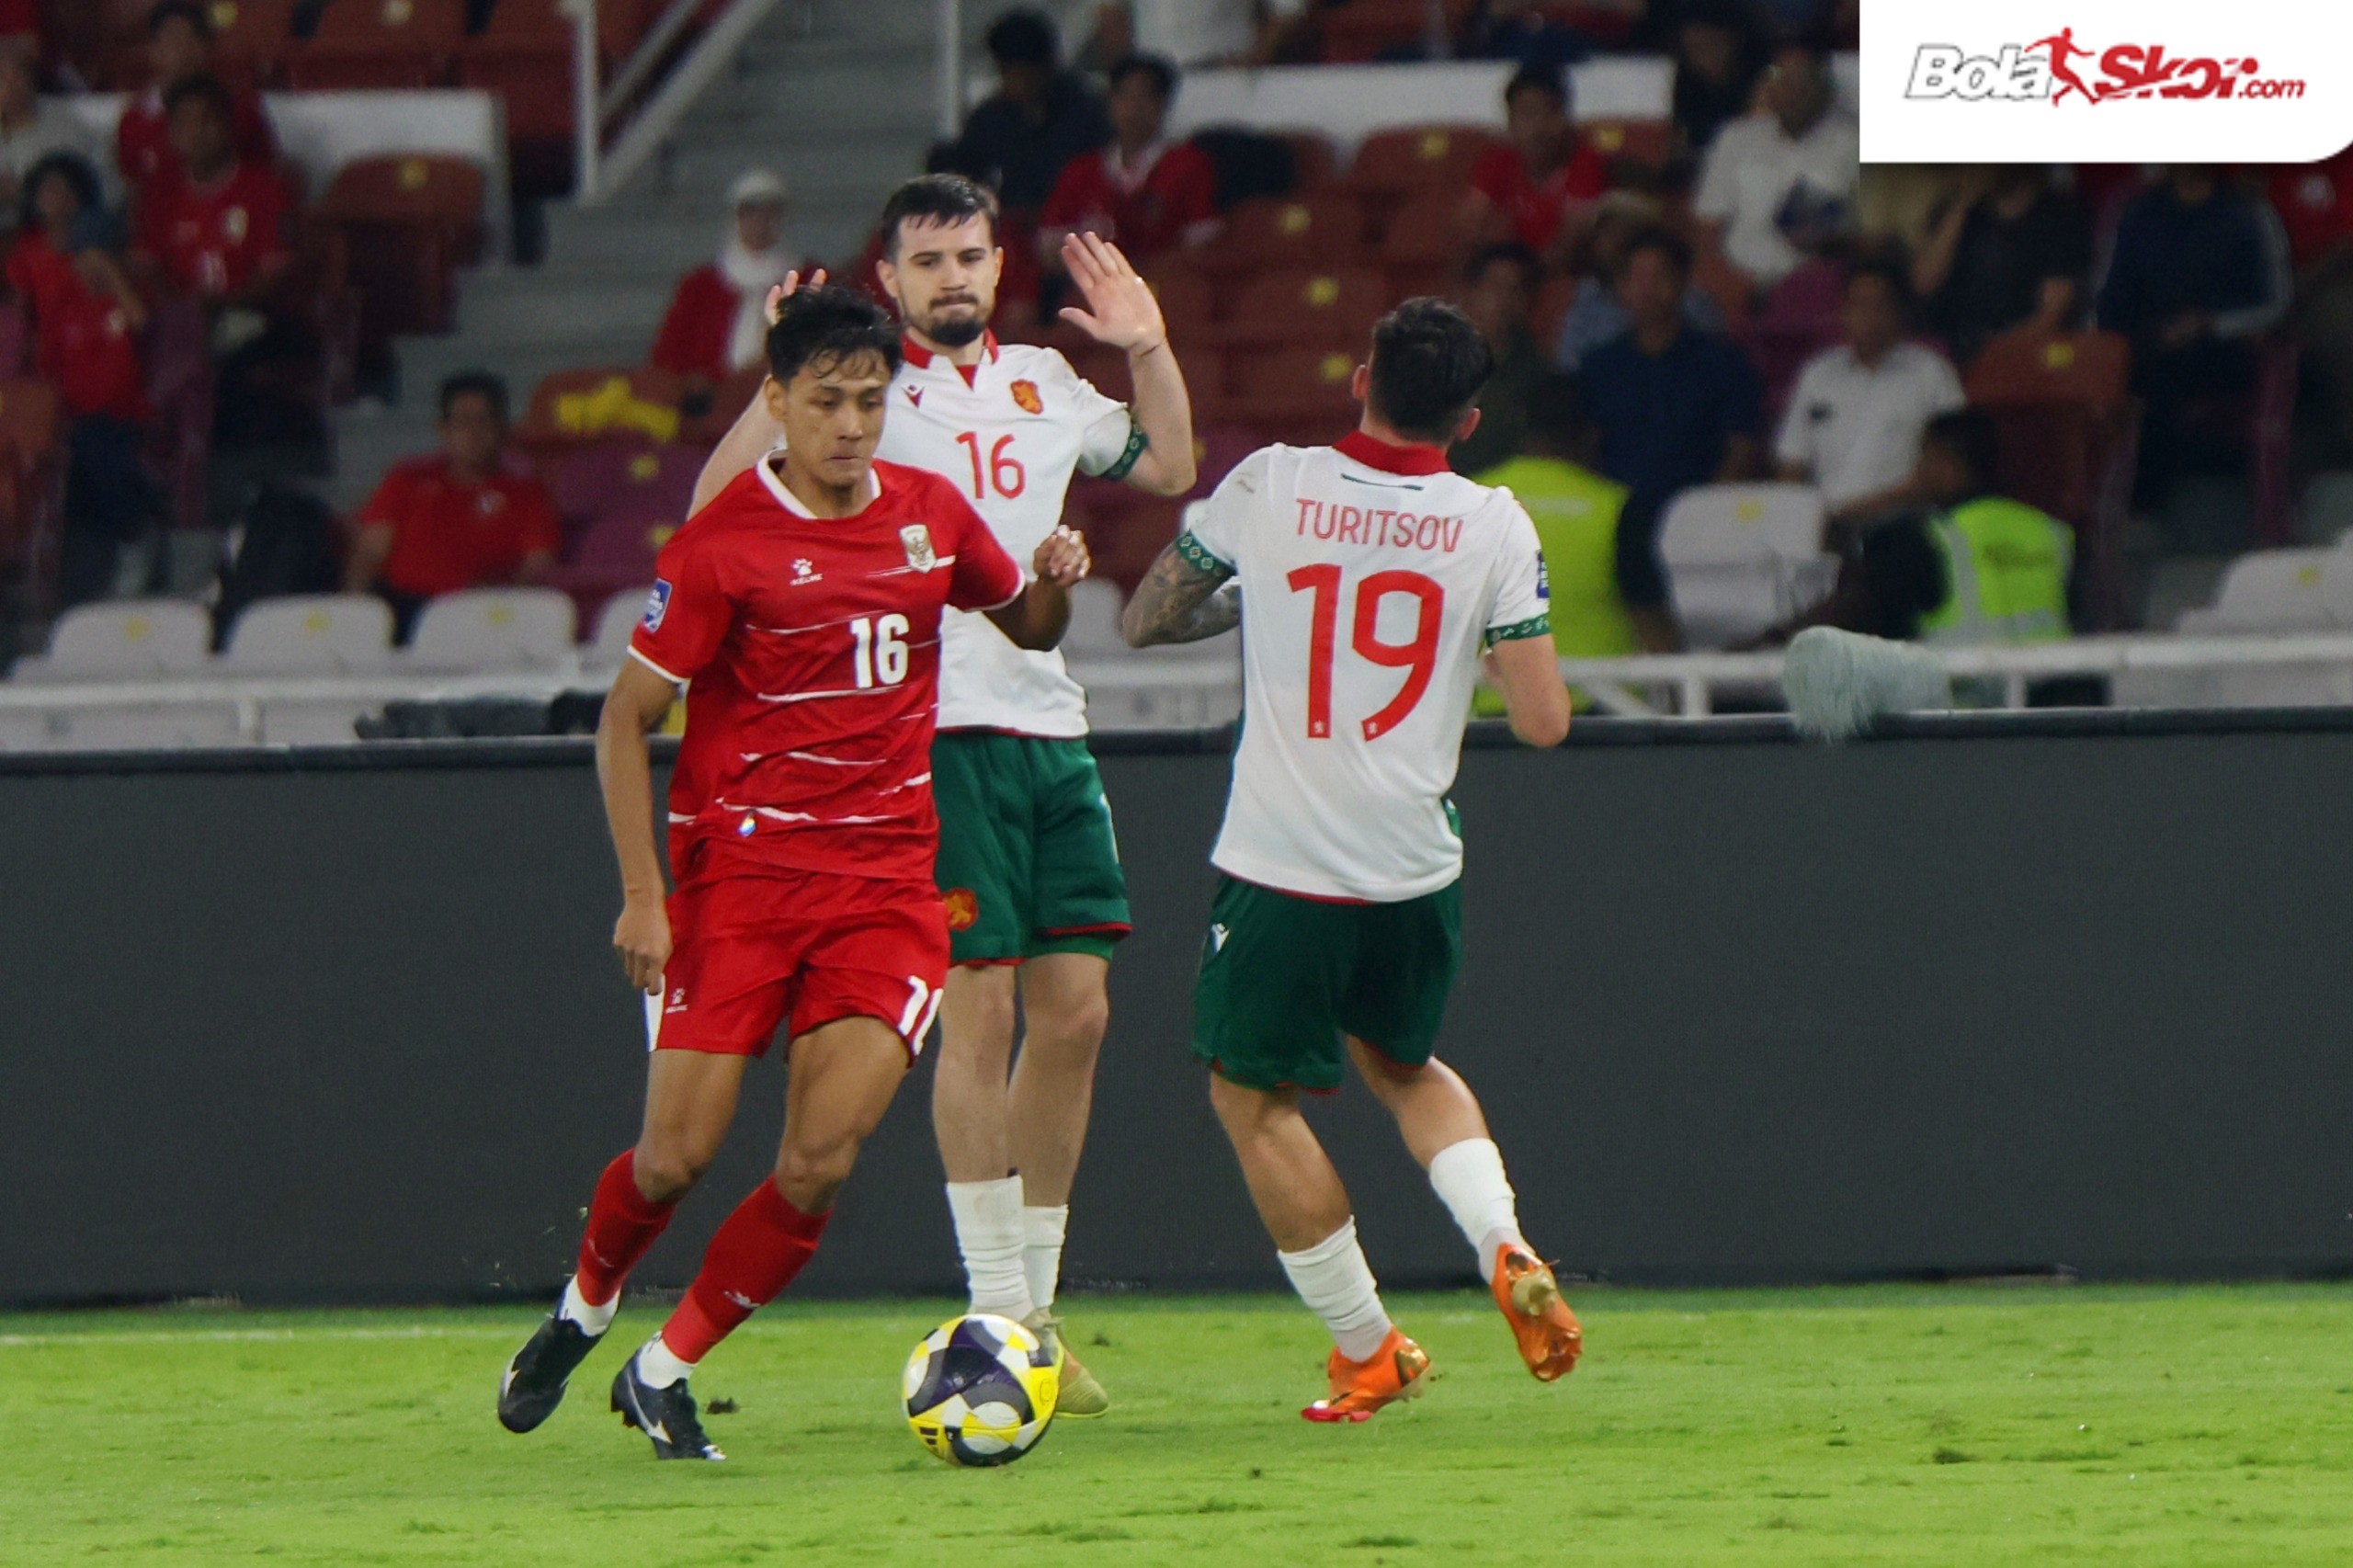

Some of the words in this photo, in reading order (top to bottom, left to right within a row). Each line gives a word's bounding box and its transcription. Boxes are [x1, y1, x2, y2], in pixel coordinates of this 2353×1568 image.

[955, 431, 1026, 499] 16
[1295, 497, 1464, 553] TURITSOV
[849, 613, 910, 688] 16
[1287, 562, 1446, 743] 19
